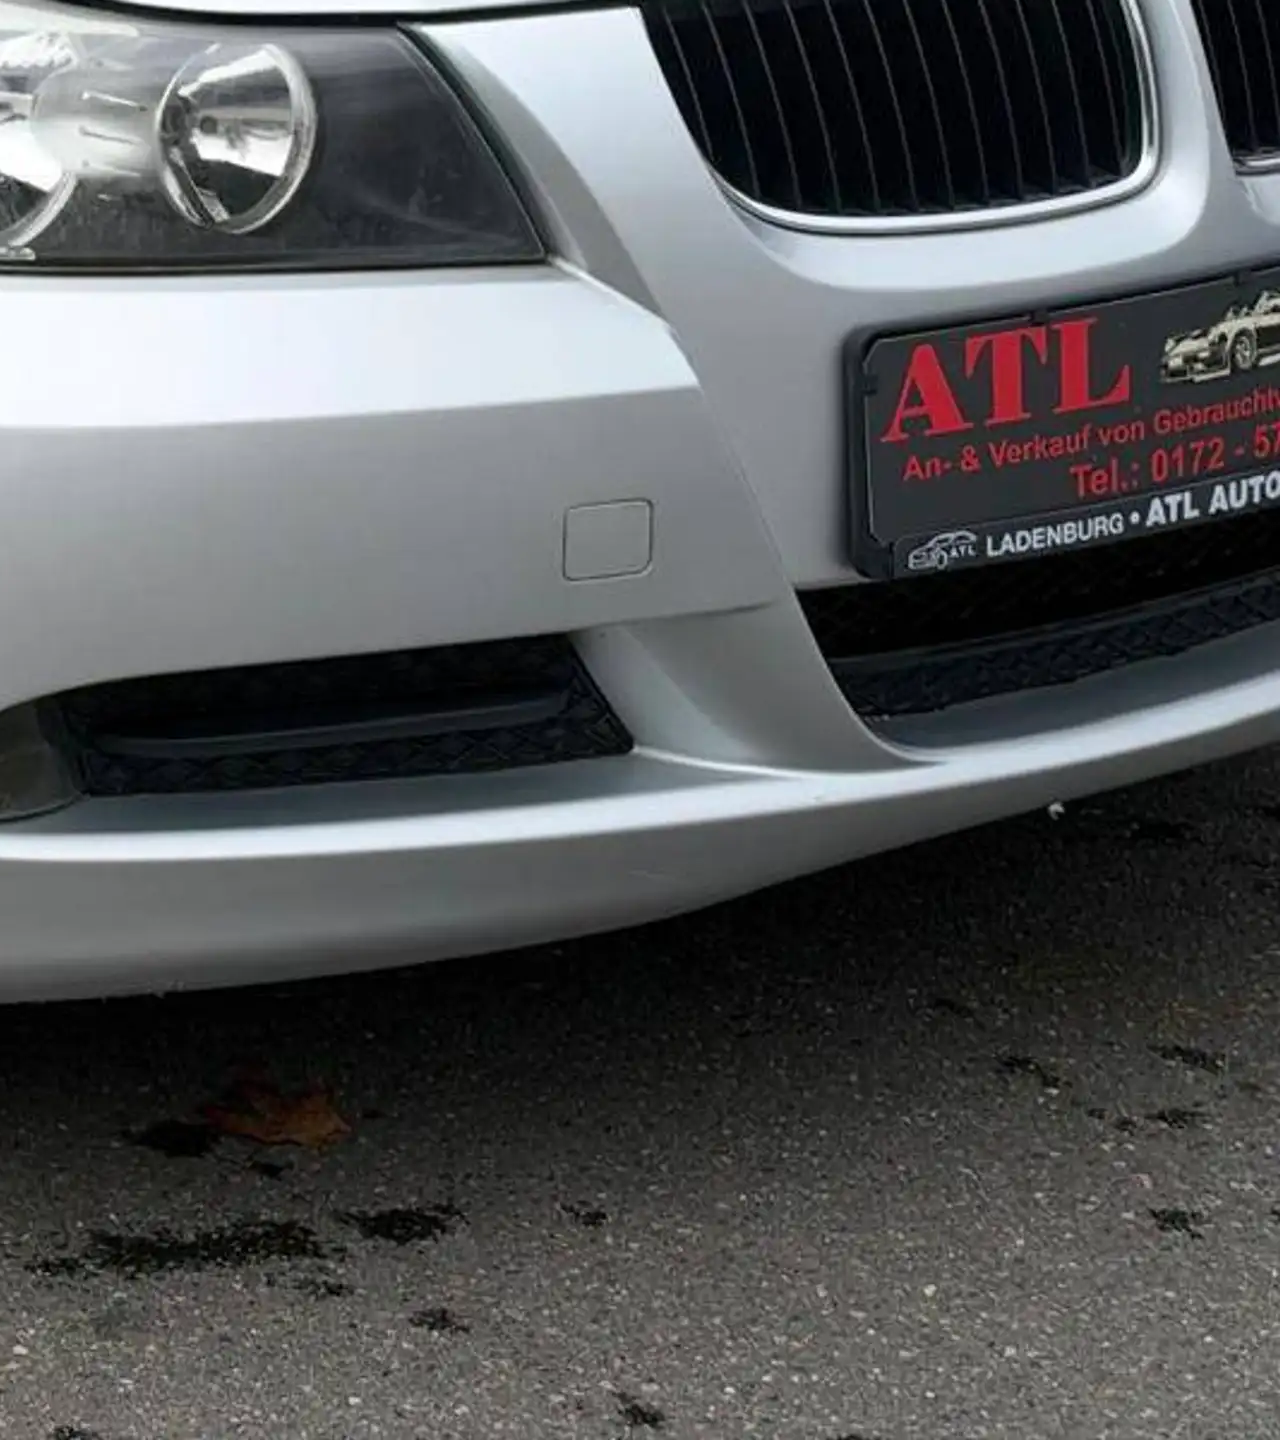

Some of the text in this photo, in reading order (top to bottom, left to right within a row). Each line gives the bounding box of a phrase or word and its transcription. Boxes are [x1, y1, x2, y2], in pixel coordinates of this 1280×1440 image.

[880, 317, 1131, 443] ATL
[903, 455, 952, 482] An-
[960, 445, 981, 472] &
[989, 423, 1092, 468] Verkauf
[1097, 418, 1145, 446] von
[1069, 457, 1140, 498] Tel.:
[1151, 436, 1225, 482] 0172
[986, 511, 1125, 557] LADENBURG
[1145, 491, 1200, 527] ATL
